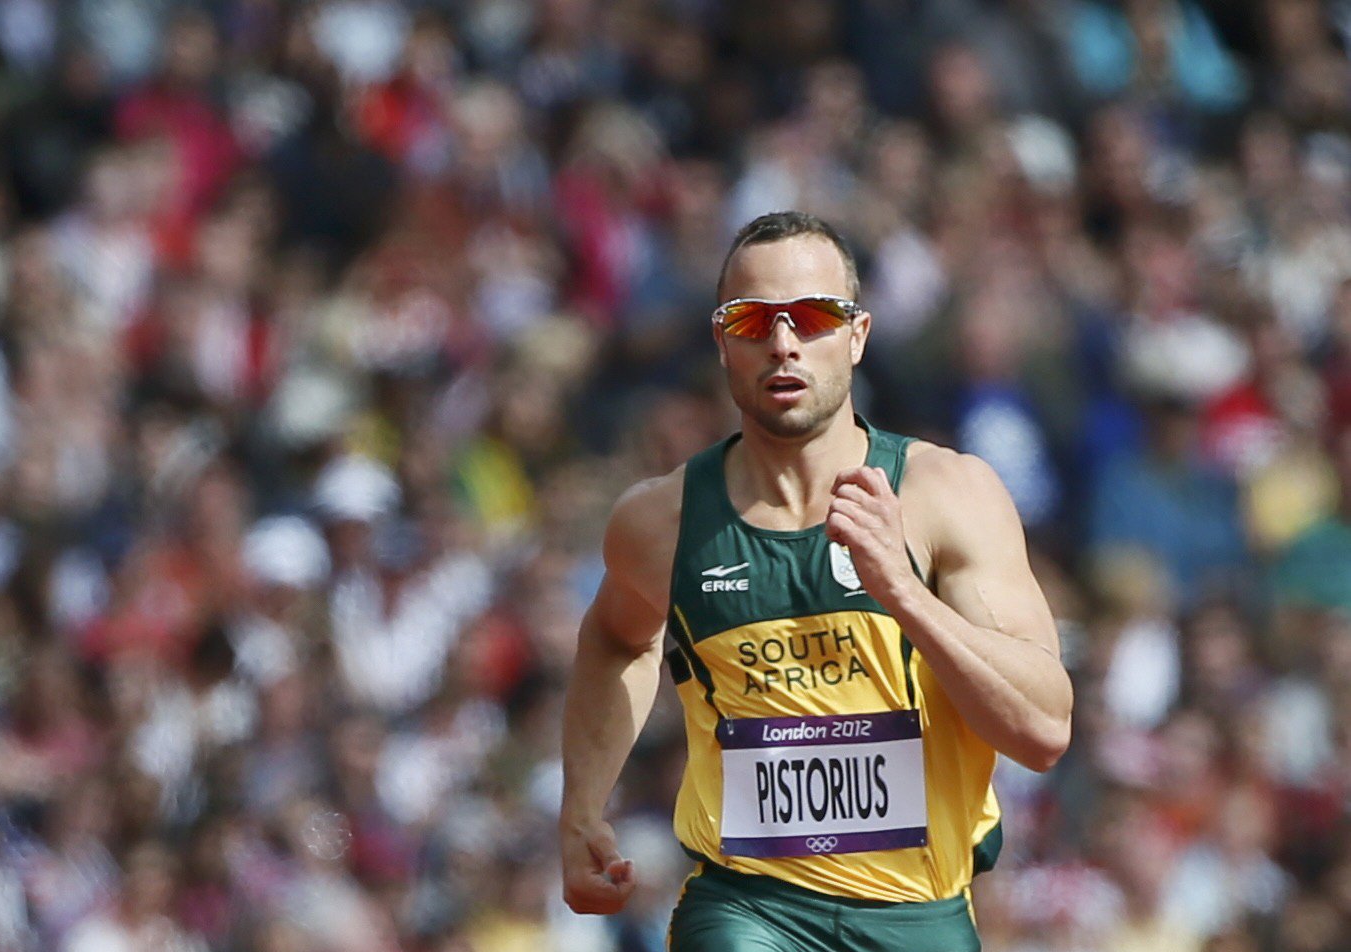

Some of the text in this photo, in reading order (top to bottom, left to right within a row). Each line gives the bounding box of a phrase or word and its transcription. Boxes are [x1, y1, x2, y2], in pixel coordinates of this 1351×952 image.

[701, 578, 749, 592] ERKE
[738, 625, 856, 667] SOUTH
[743, 655, 870, 695] AFRICA
[762, 719, 873, 742] London 2012
[756, 754, 889, 824] PISTORIUS
